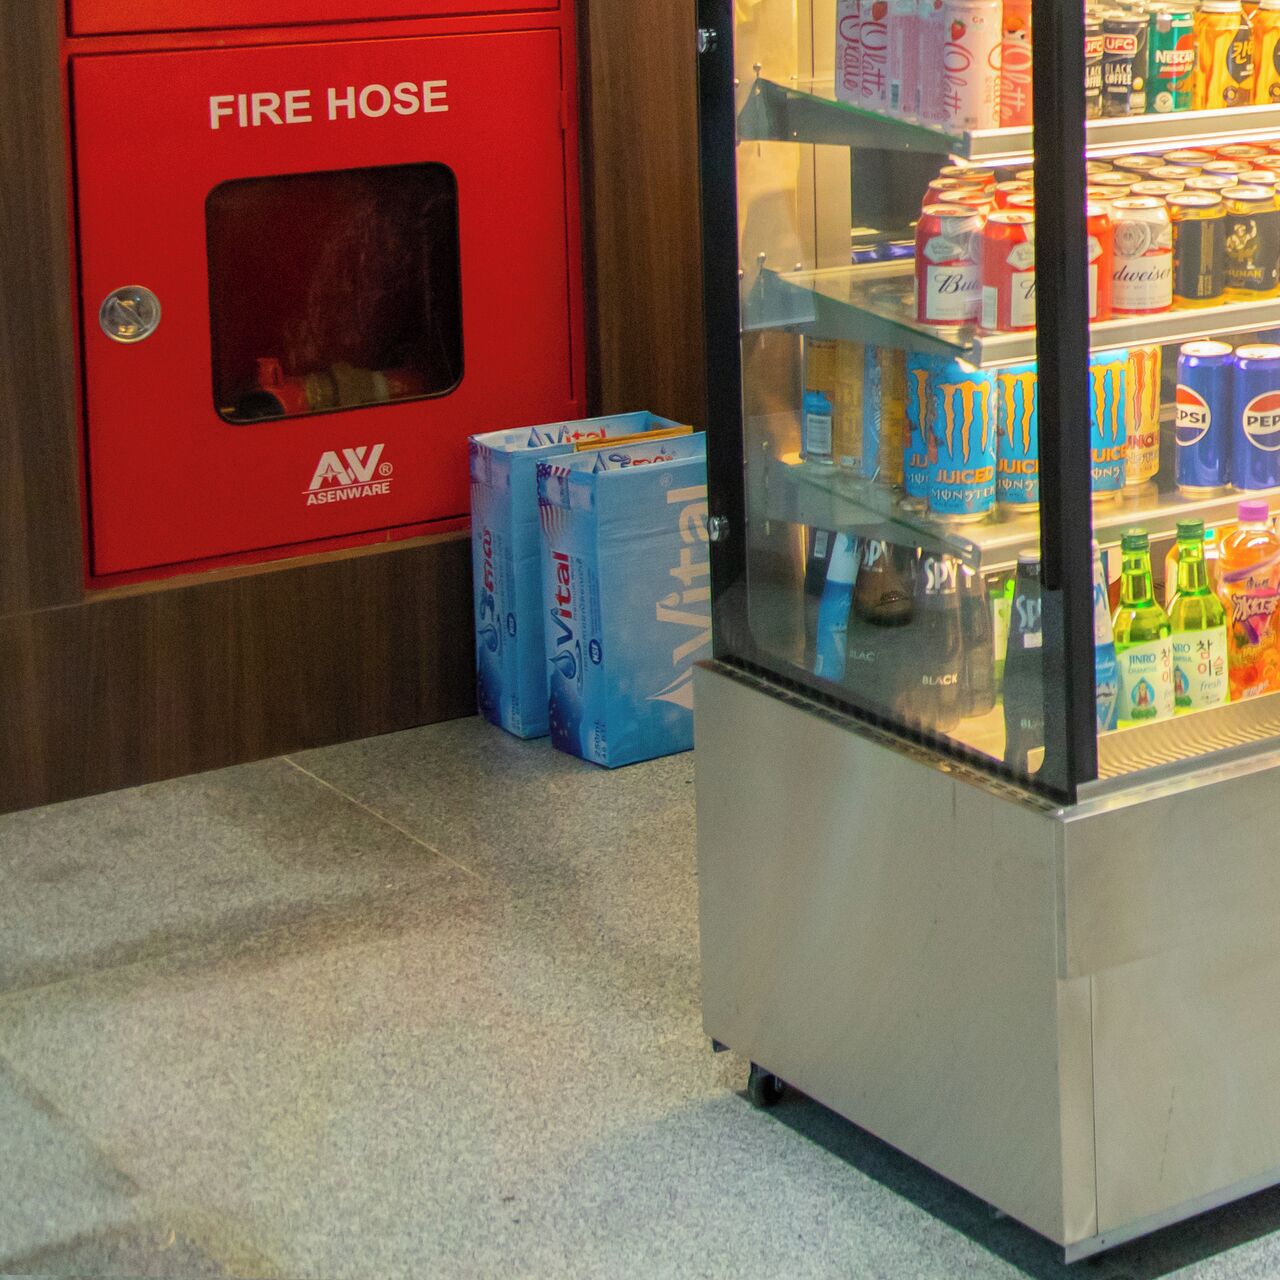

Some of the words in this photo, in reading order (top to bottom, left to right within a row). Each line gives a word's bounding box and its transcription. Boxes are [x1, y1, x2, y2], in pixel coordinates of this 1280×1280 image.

[1106, 38, 1134, 49] UFC
[1105, 63, 1132, 74] BLACK
[210, 90, 312, 130] FIRE
[328, 80, 450, 121] HOSE
[937, 469, 994, 484] JUICED
[306, 482, 390, 506] ASENWARE
[551, 550, 573, 646] Vital
[1129, 653, 1156, 664] JINRO
[922, 673, 958, 686] BLACK
[1200, 679, 1222, 690] fresh
